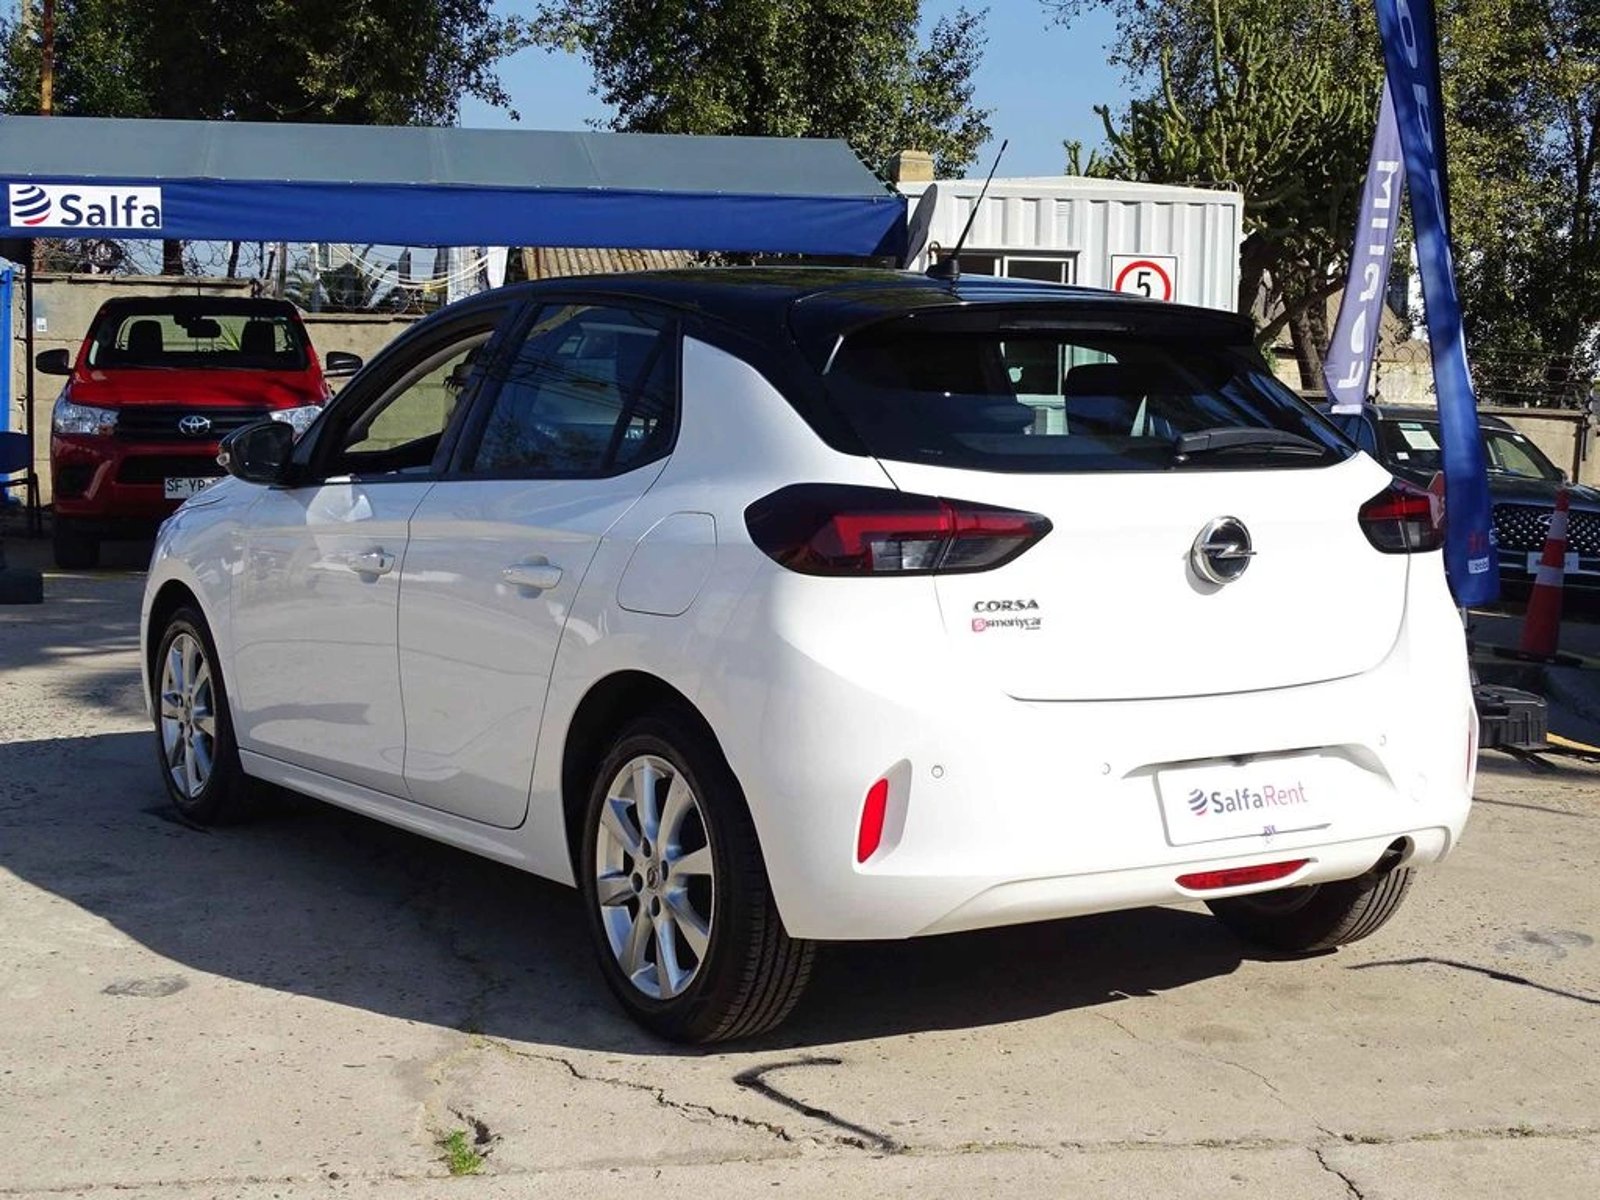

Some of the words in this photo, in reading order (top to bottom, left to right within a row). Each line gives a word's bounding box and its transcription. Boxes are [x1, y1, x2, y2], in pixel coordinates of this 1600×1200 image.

[60, 194, 160, 227] Salfa
[1137, 271, 1151, 298] 5
[973, 598, 1040, 613] CORSA
[1210, 781, 1308, 814] SalfaRent
